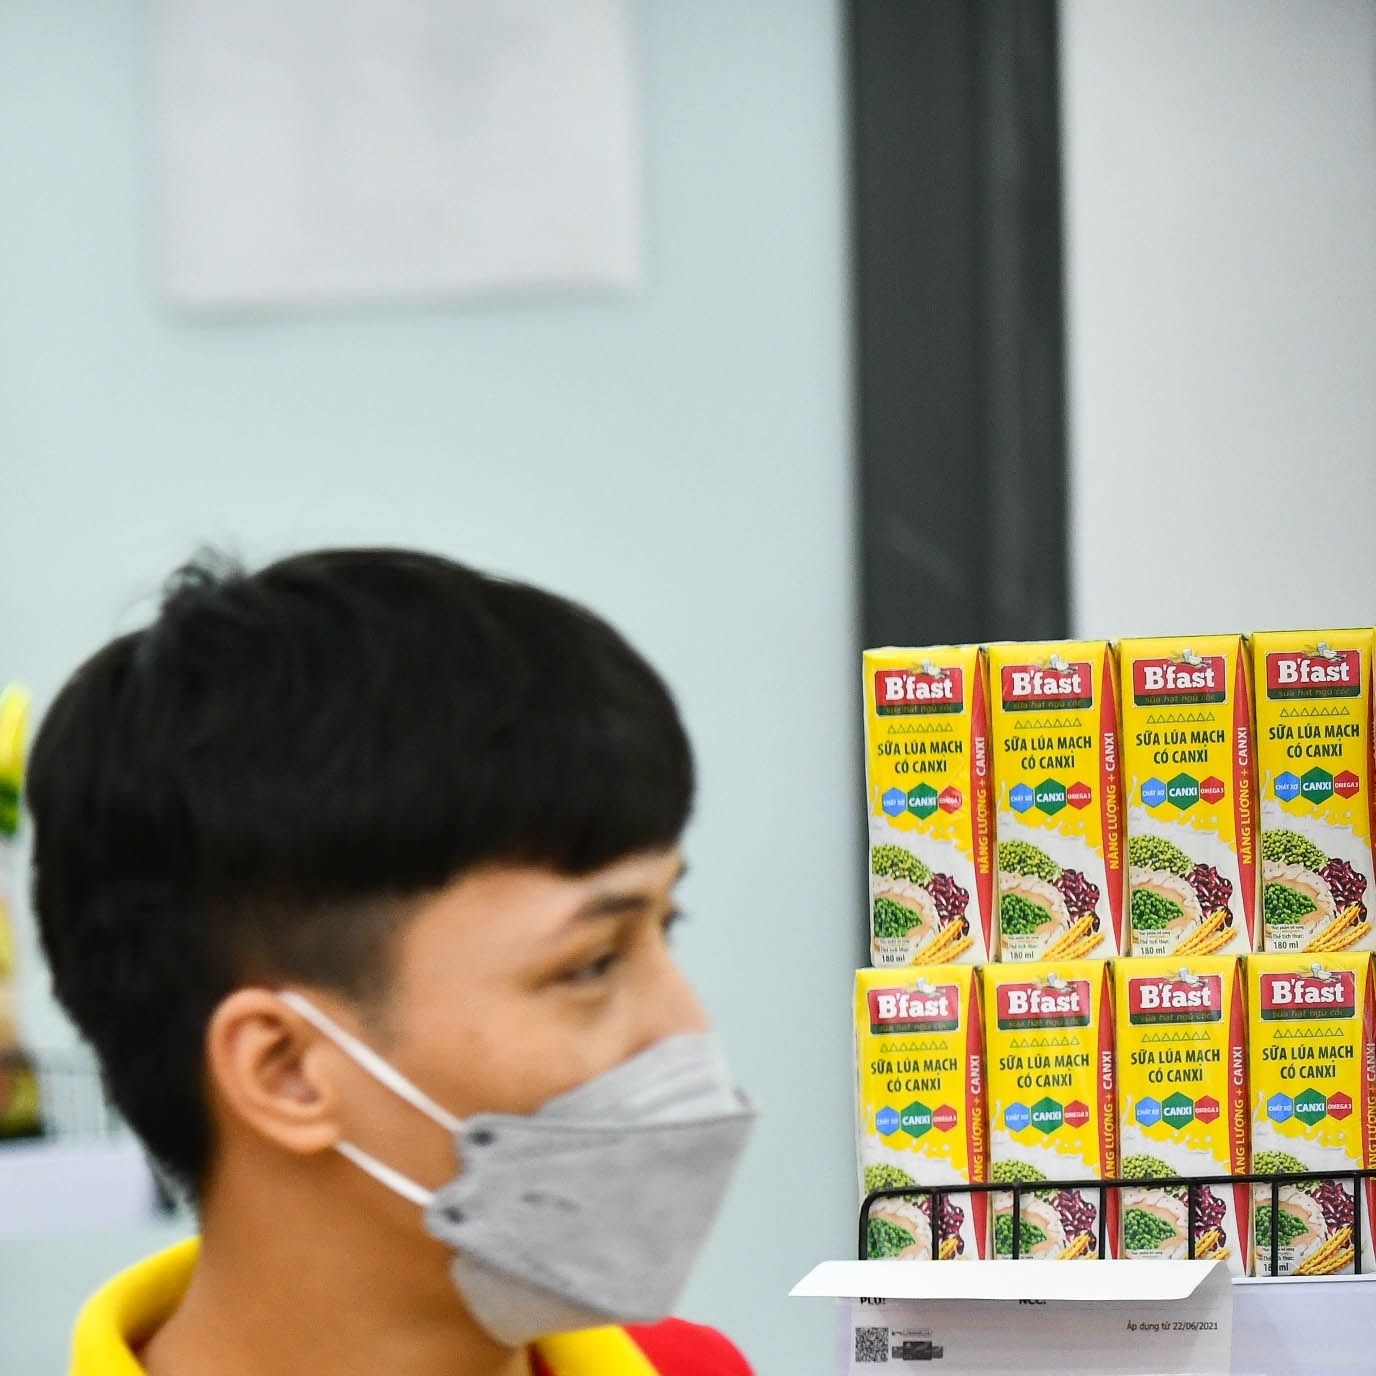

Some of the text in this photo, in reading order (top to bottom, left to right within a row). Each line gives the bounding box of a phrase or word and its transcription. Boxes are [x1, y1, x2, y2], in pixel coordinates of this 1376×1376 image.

[1144, 664, 1215, 690] B'fast
[1278, 658, 1350, 684] B'fast
[885, 675, 953, 700] B'fast
[1011, 670, 1082, 696] B'fast
[1136, 729, 1225, 747] SỮA LÚA MẠCH
[1269, 723, 1360, 742] SỮA LÚA MẠCH
[878, 740, 962, 757] SỮA LÚA MẠCH
[1004, 735, 1092, 753] SỮA LÚA MẠCH
[1104, 733, 1115, 772] CANXI
[1237, 727, 1248, 766] CANXI
[1286, 743, 1343, 758] CÓ CANXI
[975, 737, 986, 776] CANXI
[1021, 755, 1075, 770] CÓ CANXI
[1153, 749, 1208, 764] CÓ CANXI
[895, 760, 947, 774] CÓ CANXI
[1169, 787, 1198, 797] CANXI
[1302, 781, 1332, 791] CANXI
[909, 797, 936, 807] CANXI
[1036, 792, 1065, 803] CANXI
[1240, 780, 1252, 824] LƯỢNG
[1107, 785, 1120, 830] LƯỢNG
[1107, 832, 1119, 869] NĂNG
[1240, 827, 1252, 864] NĂNG
[1141, 945, 1166, 955] 180 ml
[1274, 941, 1287, 949] 180
[1139, 983, 1212, 1009] B'fast
[1271, 979, 1344, 1004] B'fast
[877, 993, 949, 1019] B'fast
[1007, 989, 1080, 1015] B'fast
[1000, 1053, 1090, 1071] SỮA LÚA MẠCH
[1131, 1048, 1221, 1066] SỮA LÚA MẠCH
[1262, 1044, 1354, 1063] SỮA LÚA MẠCH
[871, 1058, 958, 1076] SỮA LÚA MẠCH
[970, 1055, 981, 1095] CANXI
[1102, 1051, 1112, 1090] CANXI
[1232, 1046, 1243, 1086] CANXI
[1280, 1064, 1336, 1080] CÓ CANXI
[887, 1077, 941, 1092] CÓ CANXI
[1017, 1073, 1072, 1088] CÓ CANXI
[1148, 1068, 1203, 1083] CÓ CANXI
[1032, 1111, 1062, 1122] CANXI
[1163, 1106, 1192, 1116] CANXI
[1296, 1102, 1325, 1113] CANXI
[902, 1115, 931, 1126] CANXI
[1104, 1103, 1116, 1149] LƯỢNG
[1234, 1099, 1246, 1144] LƯỢNG
[973, 1155, 984, 1183] ĂNG
[1104, 1150, 1116, 1179] ĂNG
[1234, 1145, 1246, 1175] ĂNG
[1127, 1320, 1137, 1331] Áp
[1173, 1322, 1218, 1331] 22/06/2021
